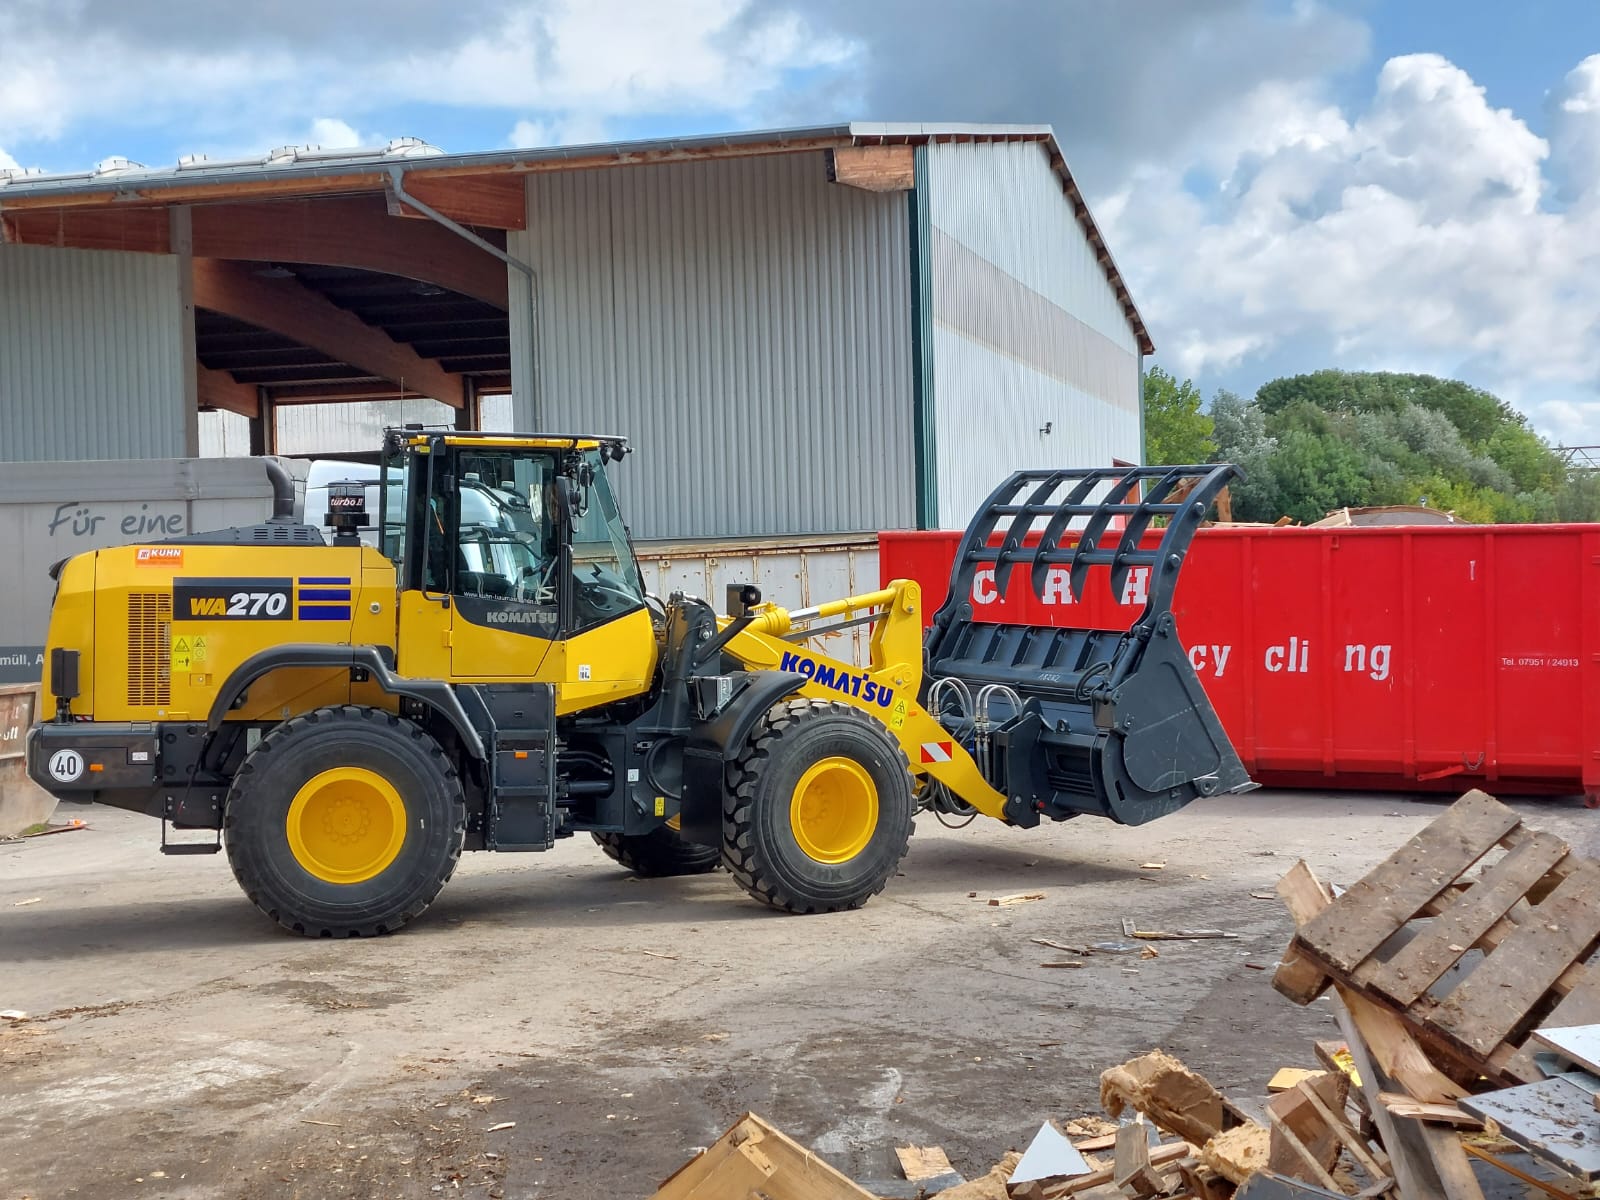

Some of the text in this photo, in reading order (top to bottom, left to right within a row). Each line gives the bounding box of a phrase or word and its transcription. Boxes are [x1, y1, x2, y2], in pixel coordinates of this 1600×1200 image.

[331, 497, 356, 506] turbo
[48, 501, 184, 536] Für eine
[151, 549, 181, 558] KUHN
[190, 592, 287, 616] WA270
[487, 609, 558, 624] KOMATSU
[1518, 658, 1544, 666] 07951
[1552, 658, 1578, 667] 24913
[780, 651, 894, 707] KOMATSU
[55, 756, 77, 775] 40
